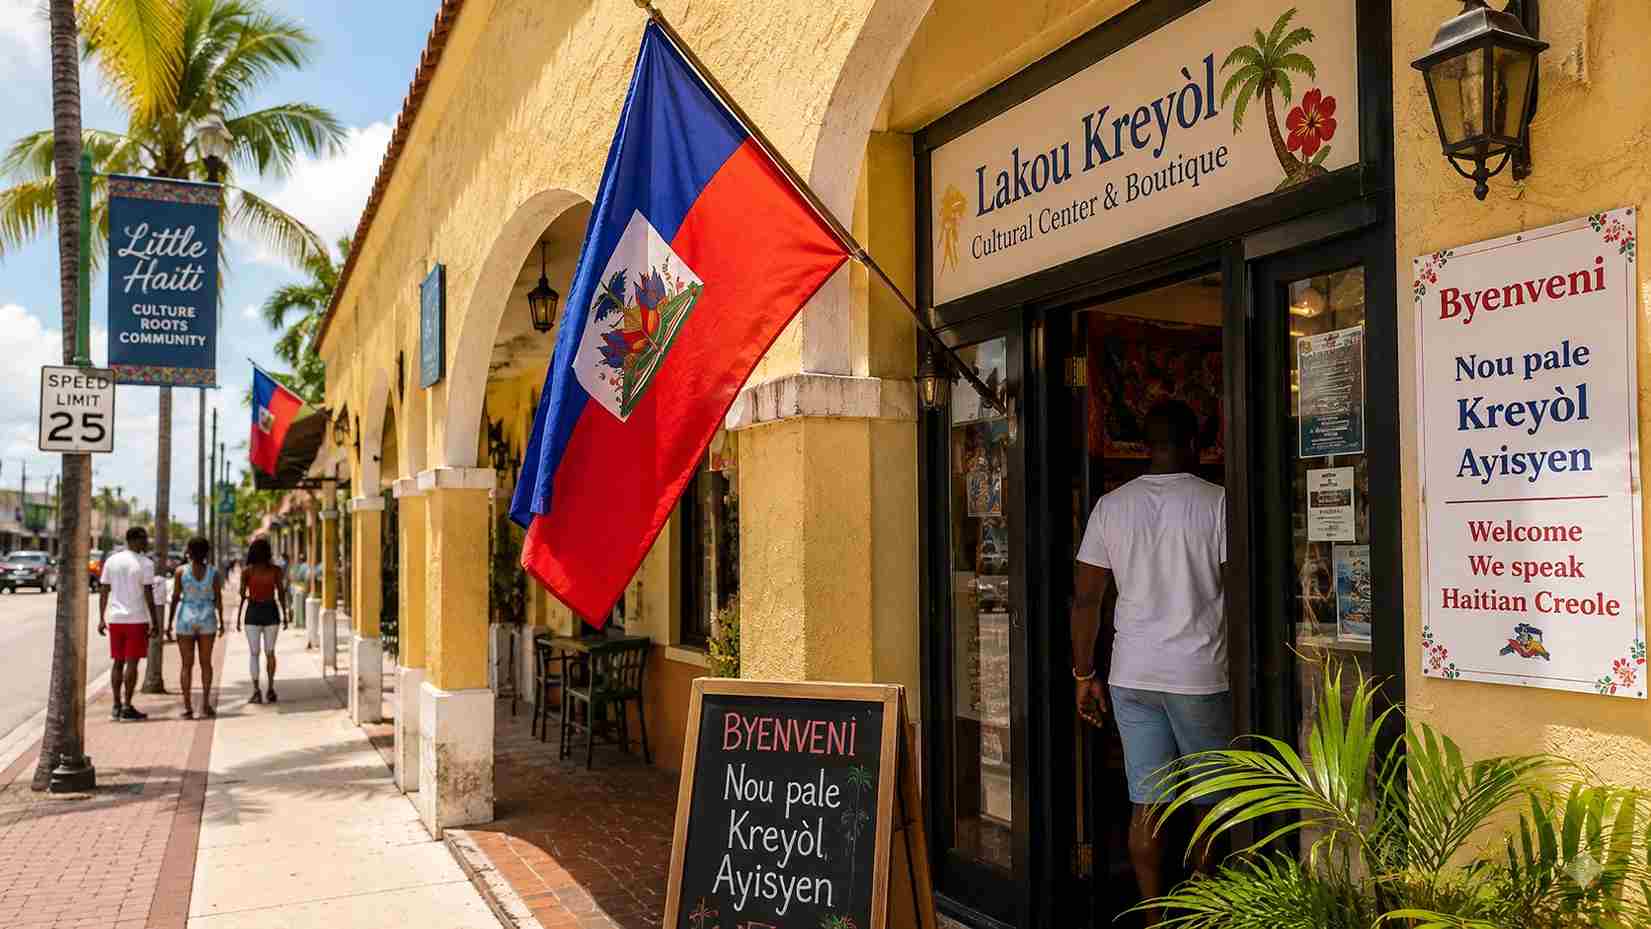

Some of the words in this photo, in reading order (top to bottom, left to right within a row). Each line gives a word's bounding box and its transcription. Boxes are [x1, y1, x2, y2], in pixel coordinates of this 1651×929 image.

[975, 141, 1072, 217] Lakou
[1082, 53, 1220, 172] Kreyòl
[971, 218, 1034, 260] Cultural
[1039, 195, 1098, 234] Center
[1103, 183, 1119, 210] &
[1126, 145, 1228, 204] Boutique
[118, 223, 208, 260] Little
[123, 258, 206, 294] Haiti
[1439, 256, 1606, 325] Byenveni
[131, 303, 196, 318] CULTURE
[141, 317, 189, 332] ROOTS
[119, 332, 206, 347] COMMUNITY
[1455, 354, 1514, 382] Nou
[1523, 340, 1590, 381] pale
[48, 374, 110, 390] SPEED
[57, 394, 101, 407] LIMIT
[1456, 383, 1590, 436] Kreyòl
[48, 412, 106, 443] 25
[1455, 447, 1593, 486] Ayisyen
[1467, 520, 1583, 543] Welcome
[1467, 555, 1505, 577] We
[1511, 554, 1586, 583] speak
[1441, 588, 1528, 613] Haitian
[1535, 590, 1621, 617] Creole
[723, 762, 774, 803] Nou
[785, 768, 841, 819] pale
[712, 853, 833, 916] Ayisyen
